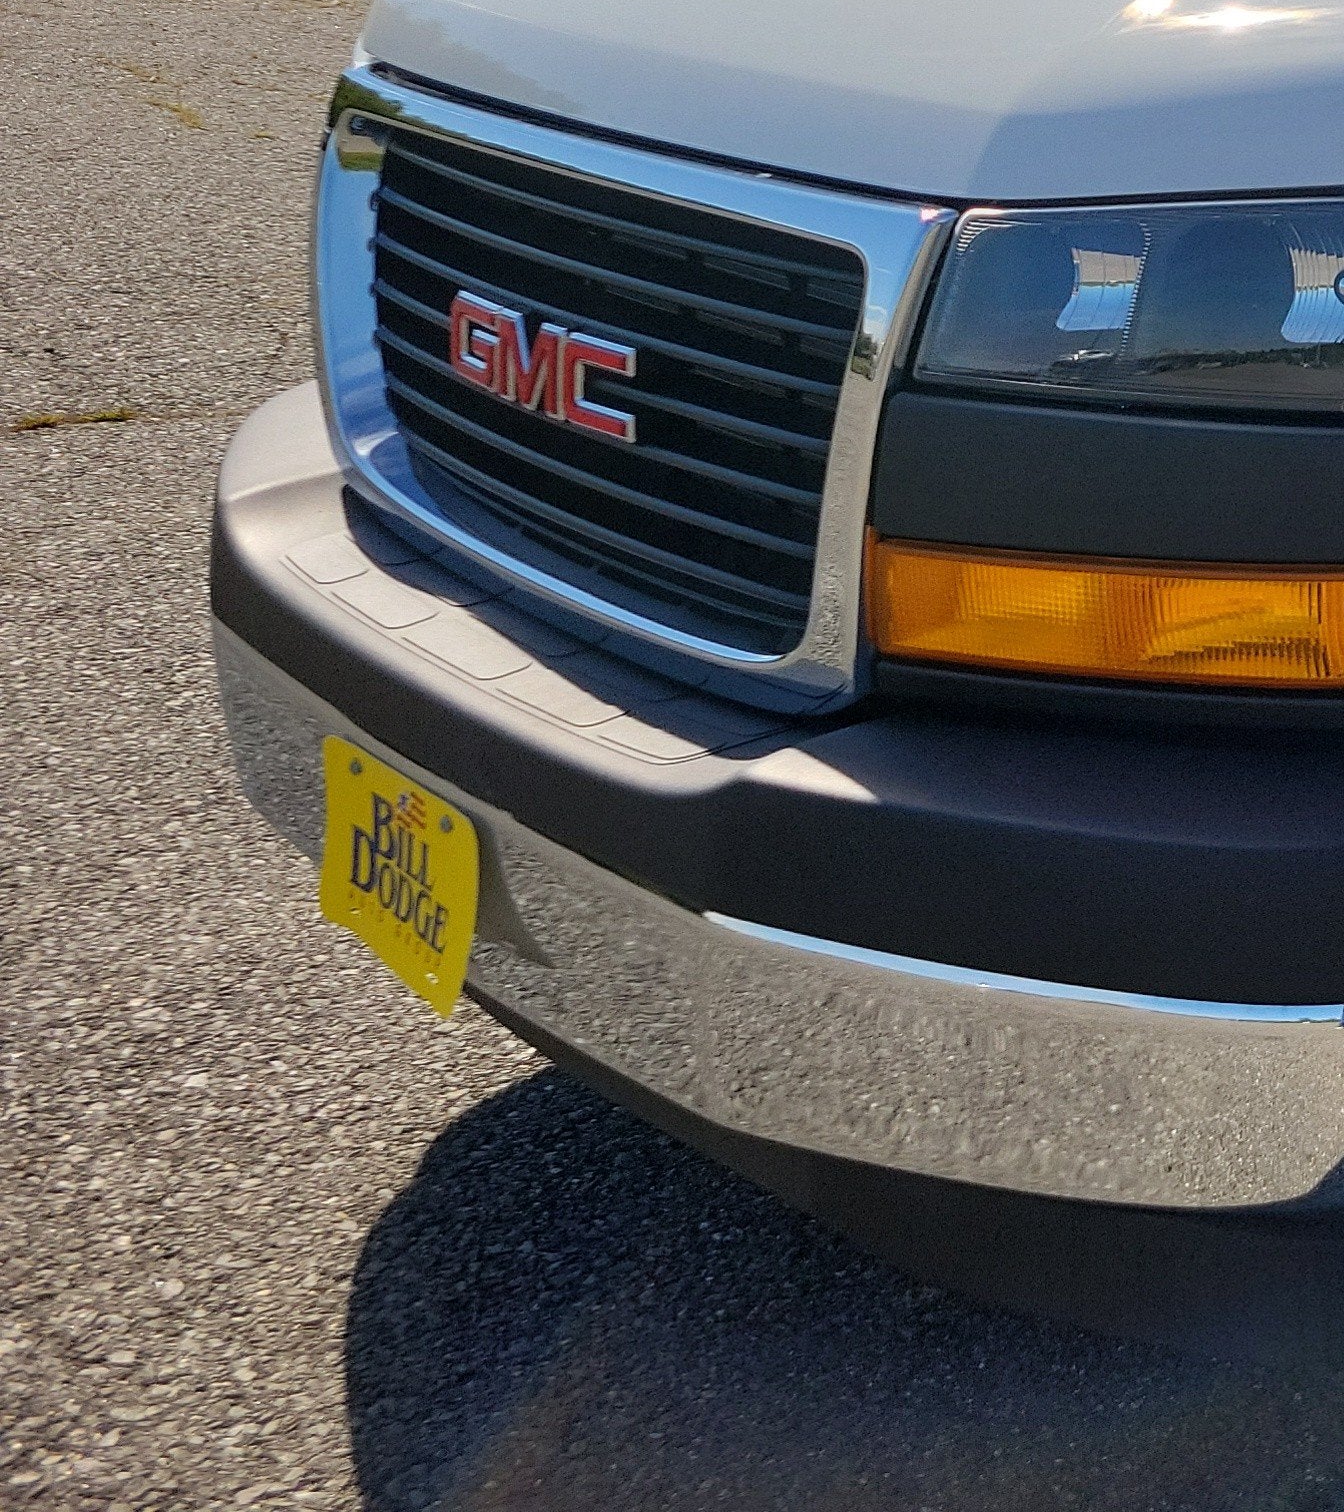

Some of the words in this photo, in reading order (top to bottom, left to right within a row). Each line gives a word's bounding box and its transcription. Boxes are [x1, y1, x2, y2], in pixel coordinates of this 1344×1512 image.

[450, 290, 636, 443] GMC
[350, 824, 449, 954] DODGE
[372, 791, 434, 892] BILL
